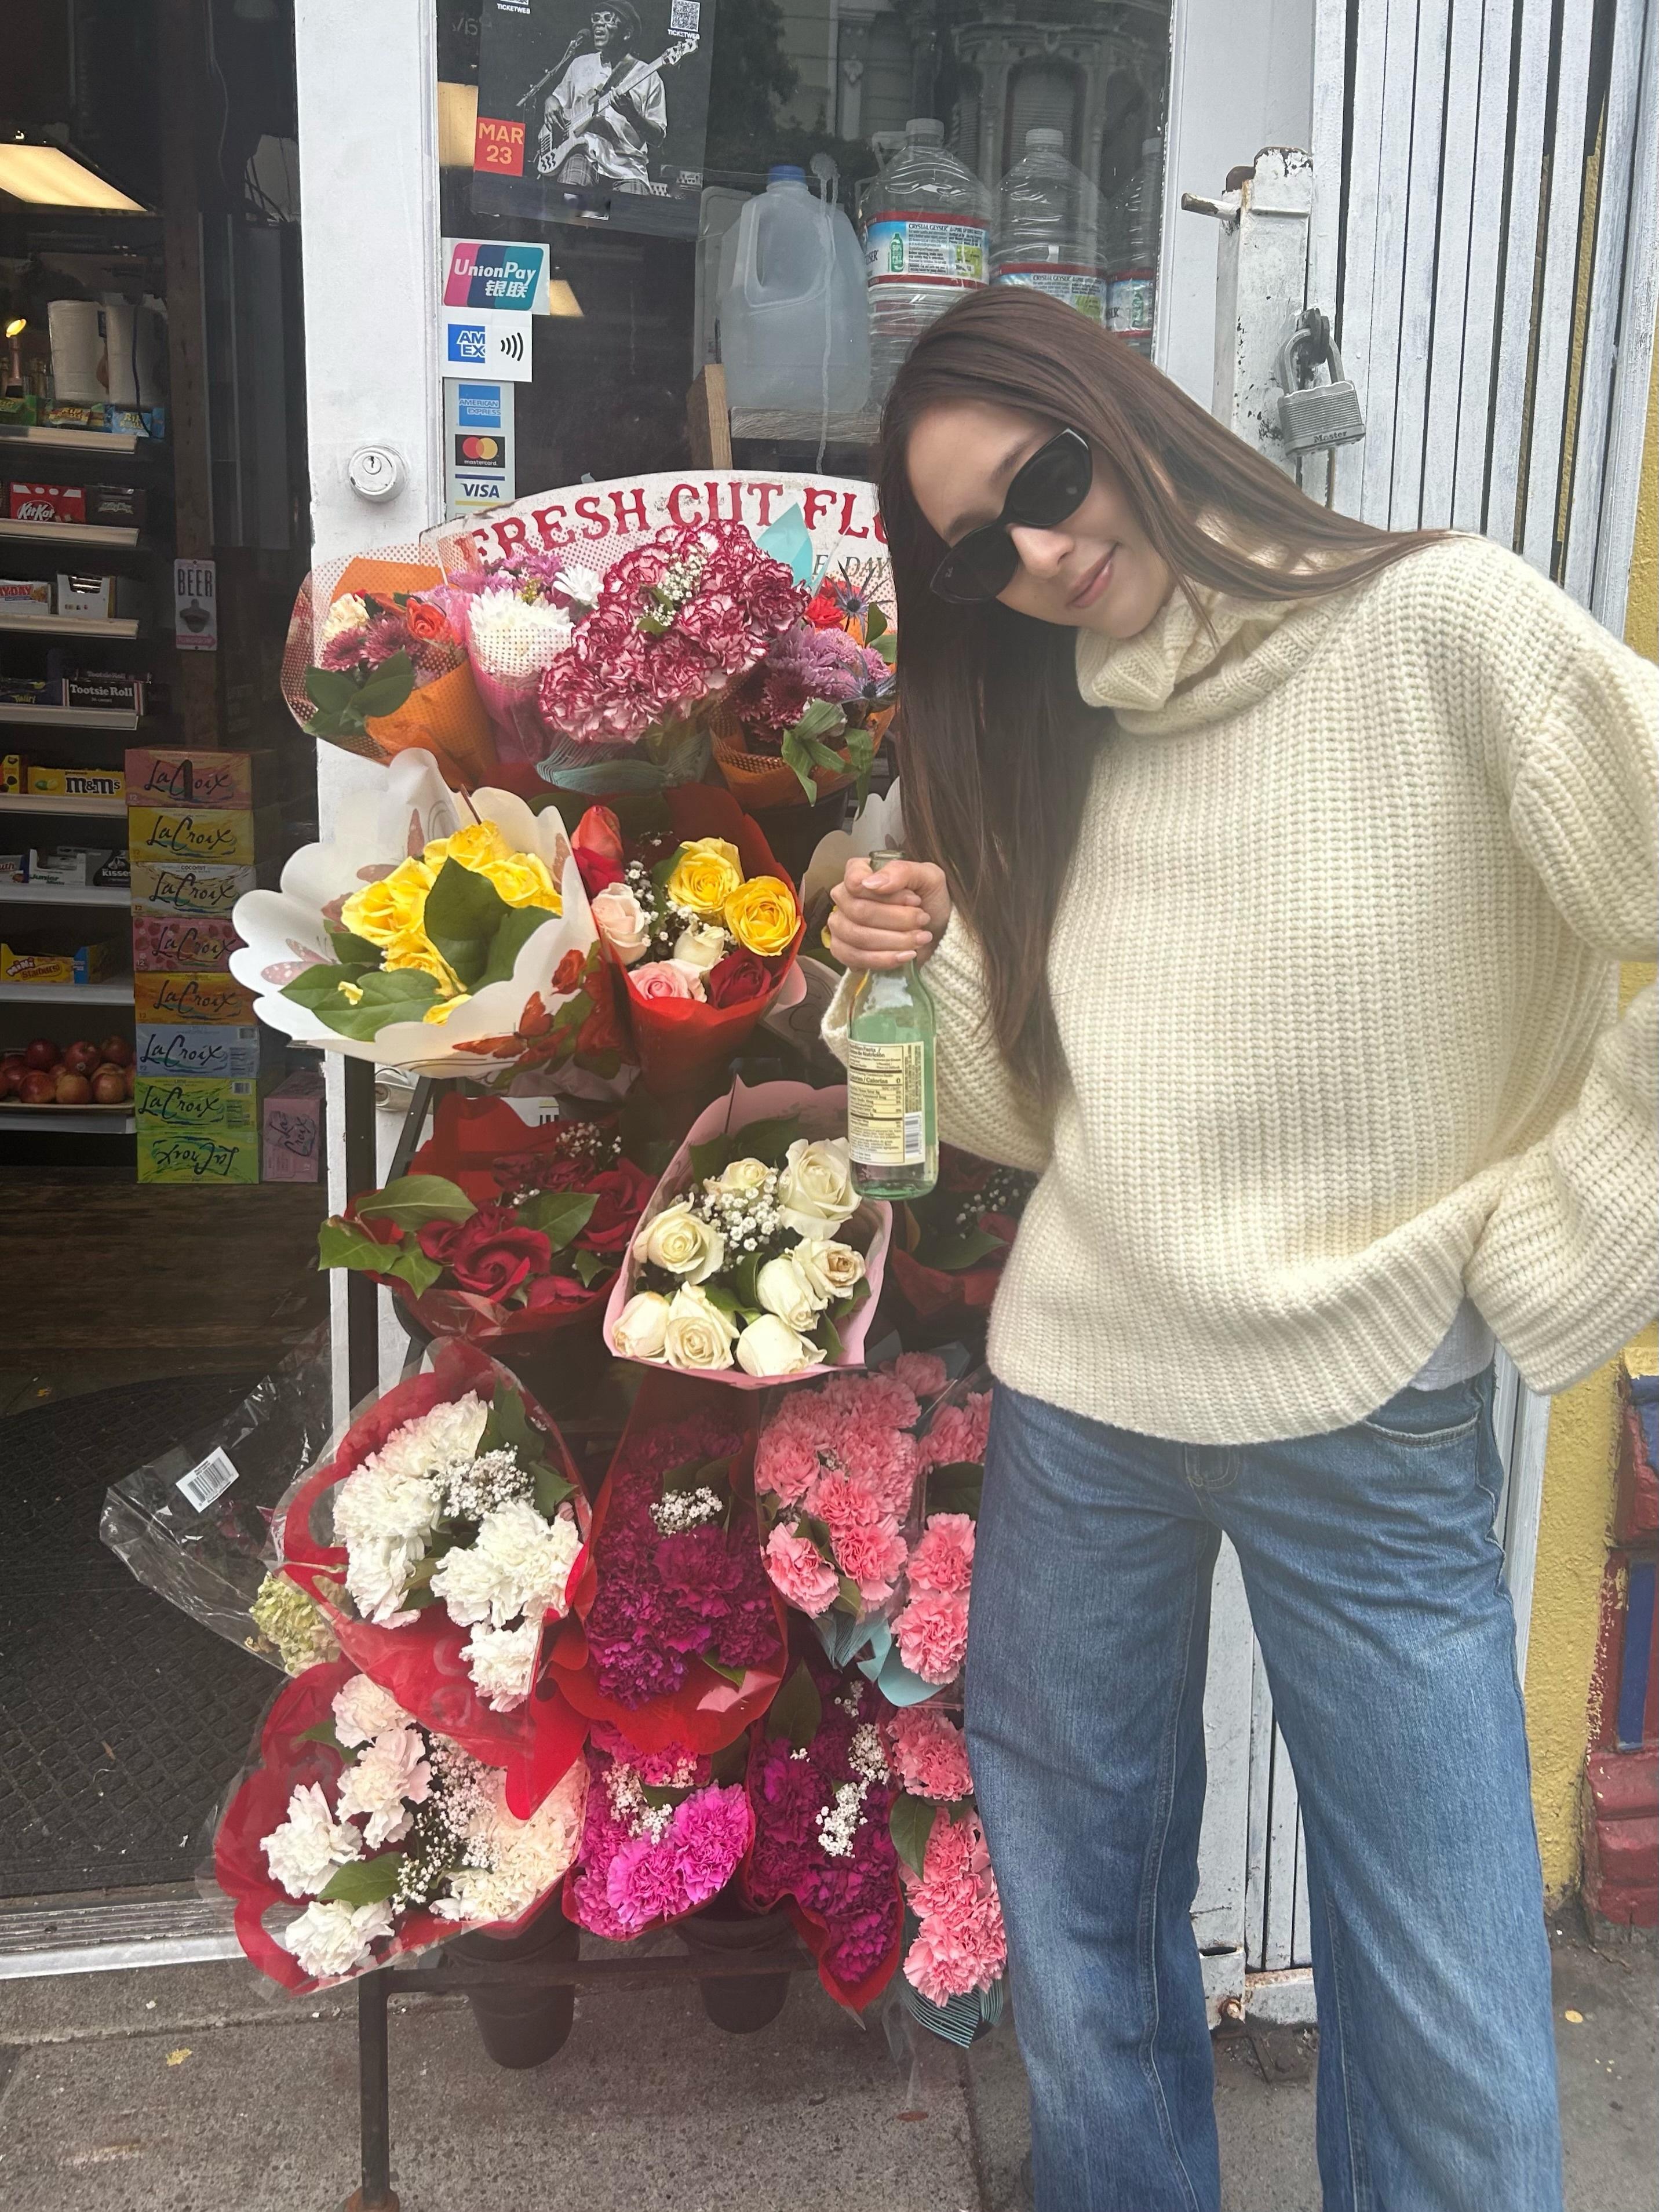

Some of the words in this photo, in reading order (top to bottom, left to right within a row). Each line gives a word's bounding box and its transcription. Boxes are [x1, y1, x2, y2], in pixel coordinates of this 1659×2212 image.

[497, 3, 531, 14] TICKETWEB
[479, 122, 524, 145] MAR
[486, 144, 512, 165] 23
[453, 258, 537, 286] UnionPay
[484, 280, 528, 298] 银联
[458, 330, 486, 345] AM
[461, 344, 486, 358] EX
[459, 399, 498, 408] AMERICAN
[468, 408, 501, 416] EXPRESS
[1312, 431, 1347, 443] Master
[460, 483, 500, 498] VISA
[18, 502, 56, 521] KitKat
[454, 488, 650, 559] FRESH
[666, 482, 783, 527] CUT
[845, 556, 891, 578] DAY
[177, 569, 213, 597] BEER
[70, 684, 110, 696] Tootsie
[110, 687, 133, 697] Roll
[144, 759, 232, 796] LaCoix
[145, 815, 234, 851] LaCroix
[0, 862, 15, 872] uth
[149, 871, 237, 907] LaCroix
[152, 926, 236, 961] LaCroix
[153, 979, 238, 1014] LaCroix
[140, 1033, 224, 1067] LaCroix
[138, 1085, 221, 1120] LaCroix
